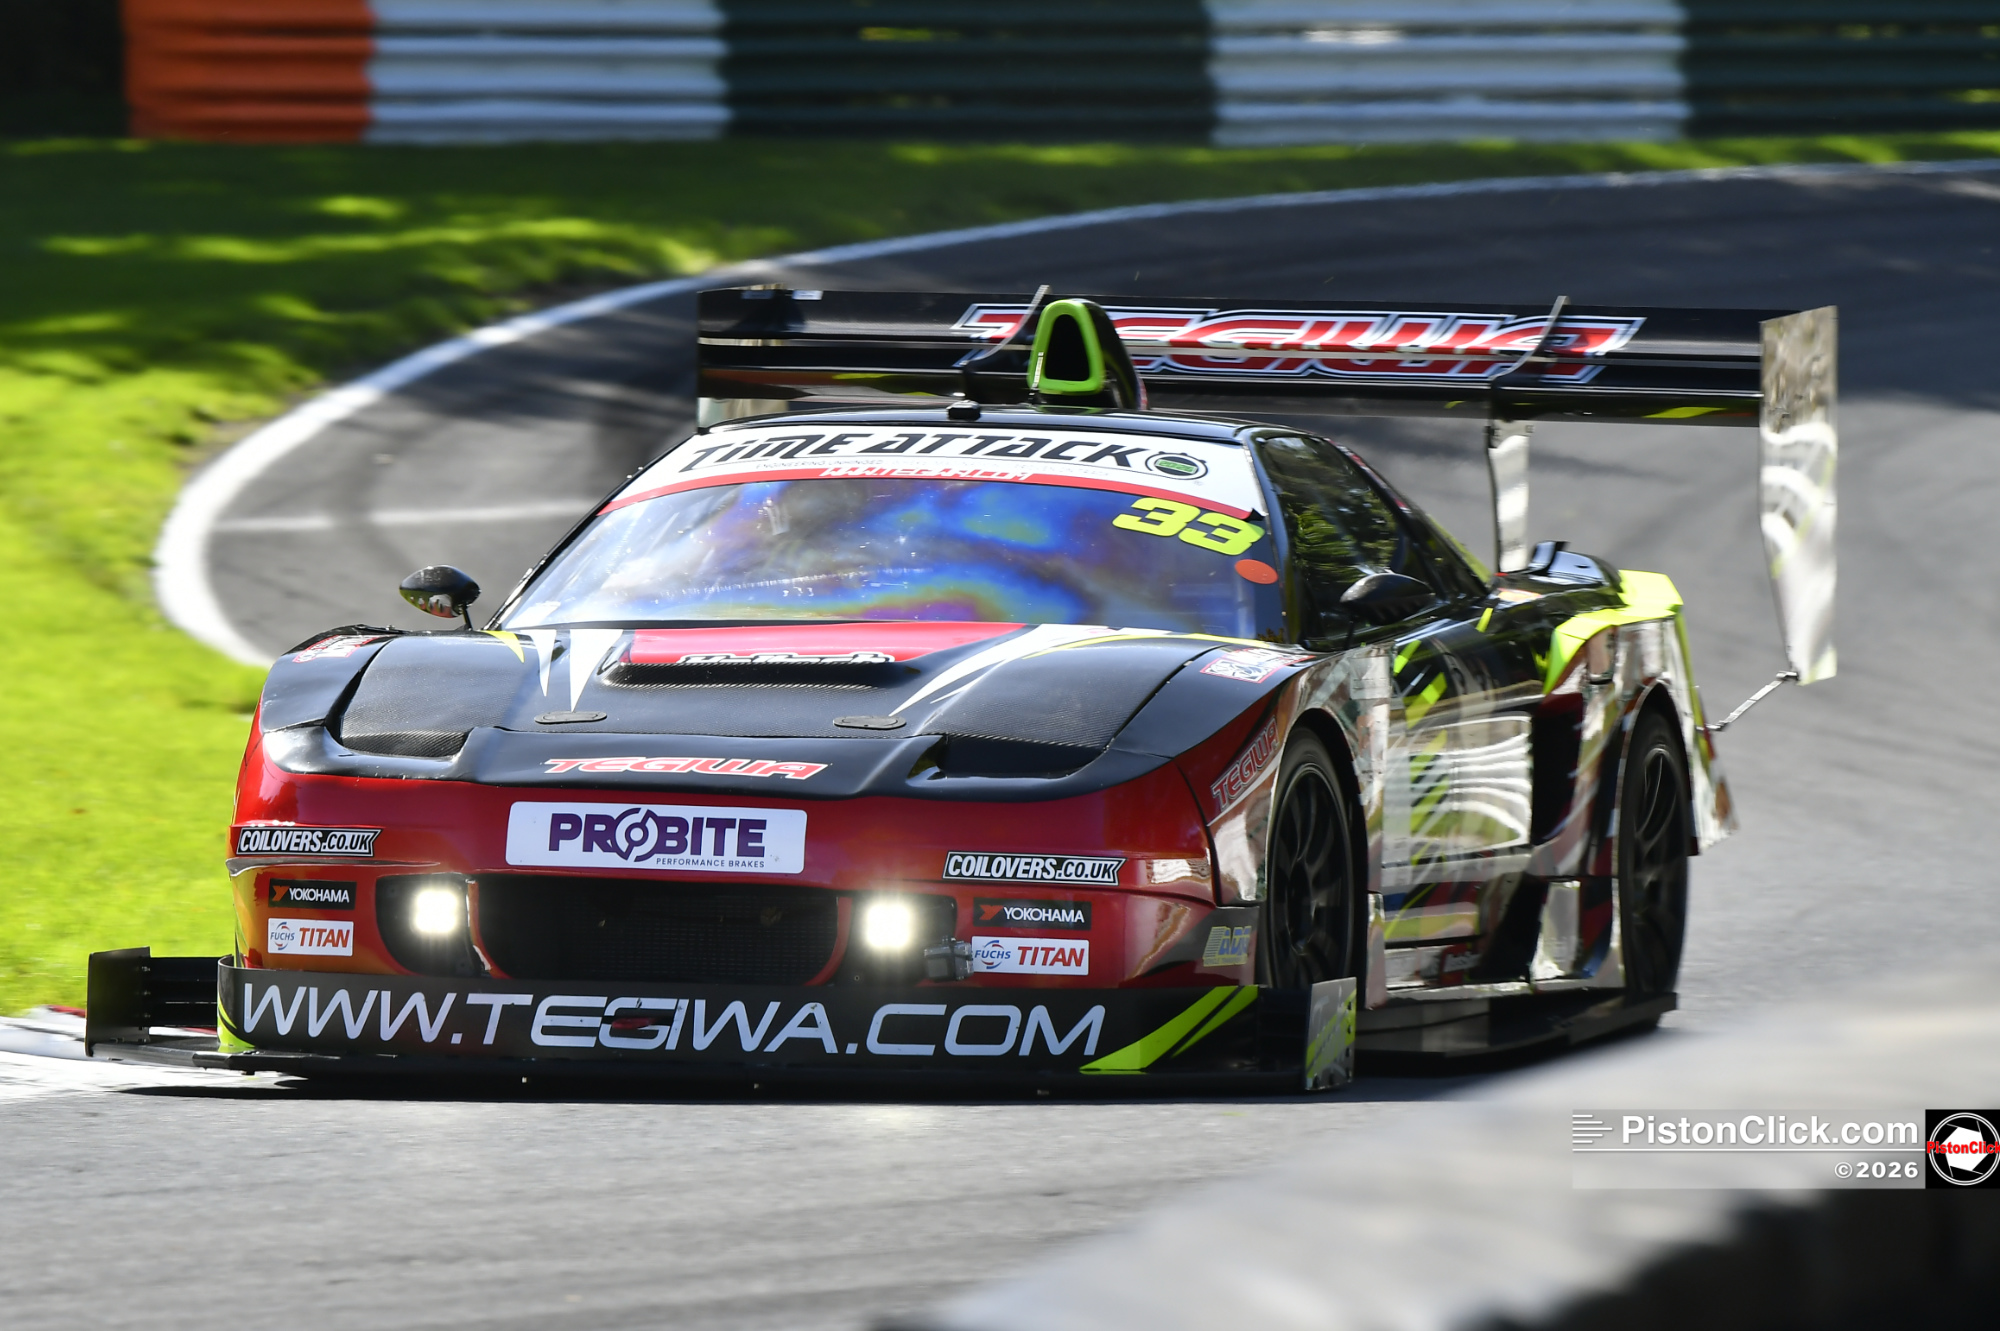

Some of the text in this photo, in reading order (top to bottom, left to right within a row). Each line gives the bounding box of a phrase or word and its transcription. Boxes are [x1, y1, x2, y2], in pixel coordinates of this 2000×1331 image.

[1112, 497, 1265, 556] 33
[545, 757, 829, 780] TEGIWA
[1210, 715, 1279, 812] TEGIWA
[240, 830, 372, 852] COILOVERS.CO.UK
[549, 807, 767, 862] PROBITE
[656, 857, 765, 868] PERFORMANCE BRAKES
[947, 855, 1115, 881] COILOVERS.CO.UK
[289, 887, 350, 903] YOKOHAMA
[1003, 906, 1084, 923] YOKOHAMA
[270, 931, 295, 942] FUCHS
[299, 927, 350, 948] TITAN
[974, 949, 1011, 961] FUCHS
[1018, 946, 1084, 967] TITAN
[243, 983, 1106, 1057] WWW.TEGIWA.COM
